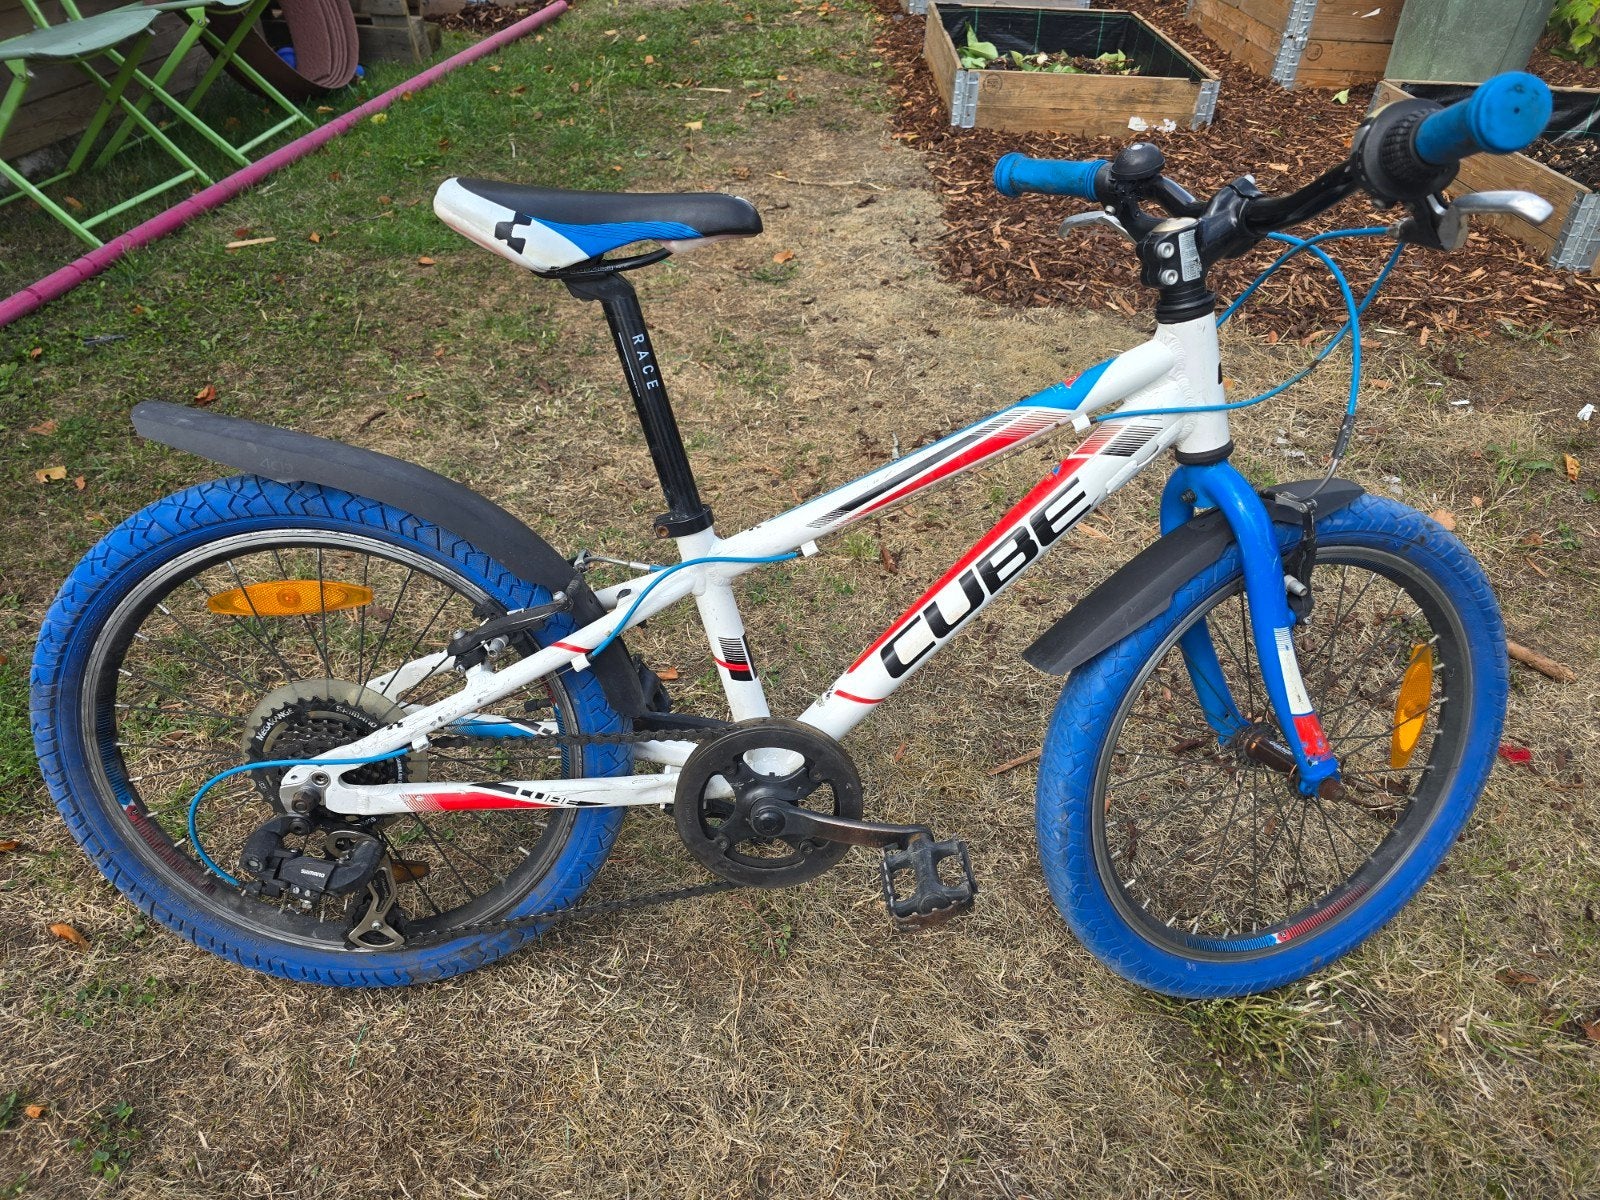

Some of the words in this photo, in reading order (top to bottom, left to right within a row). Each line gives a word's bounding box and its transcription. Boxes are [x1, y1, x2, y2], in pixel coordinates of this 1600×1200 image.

[632, 333, 659, 391] RACE
[880, 477, 1091, 679] CUBE
[255, 708, 295, 742] MEGARANGE
[300, 868, 326, 878] SHIMANO
